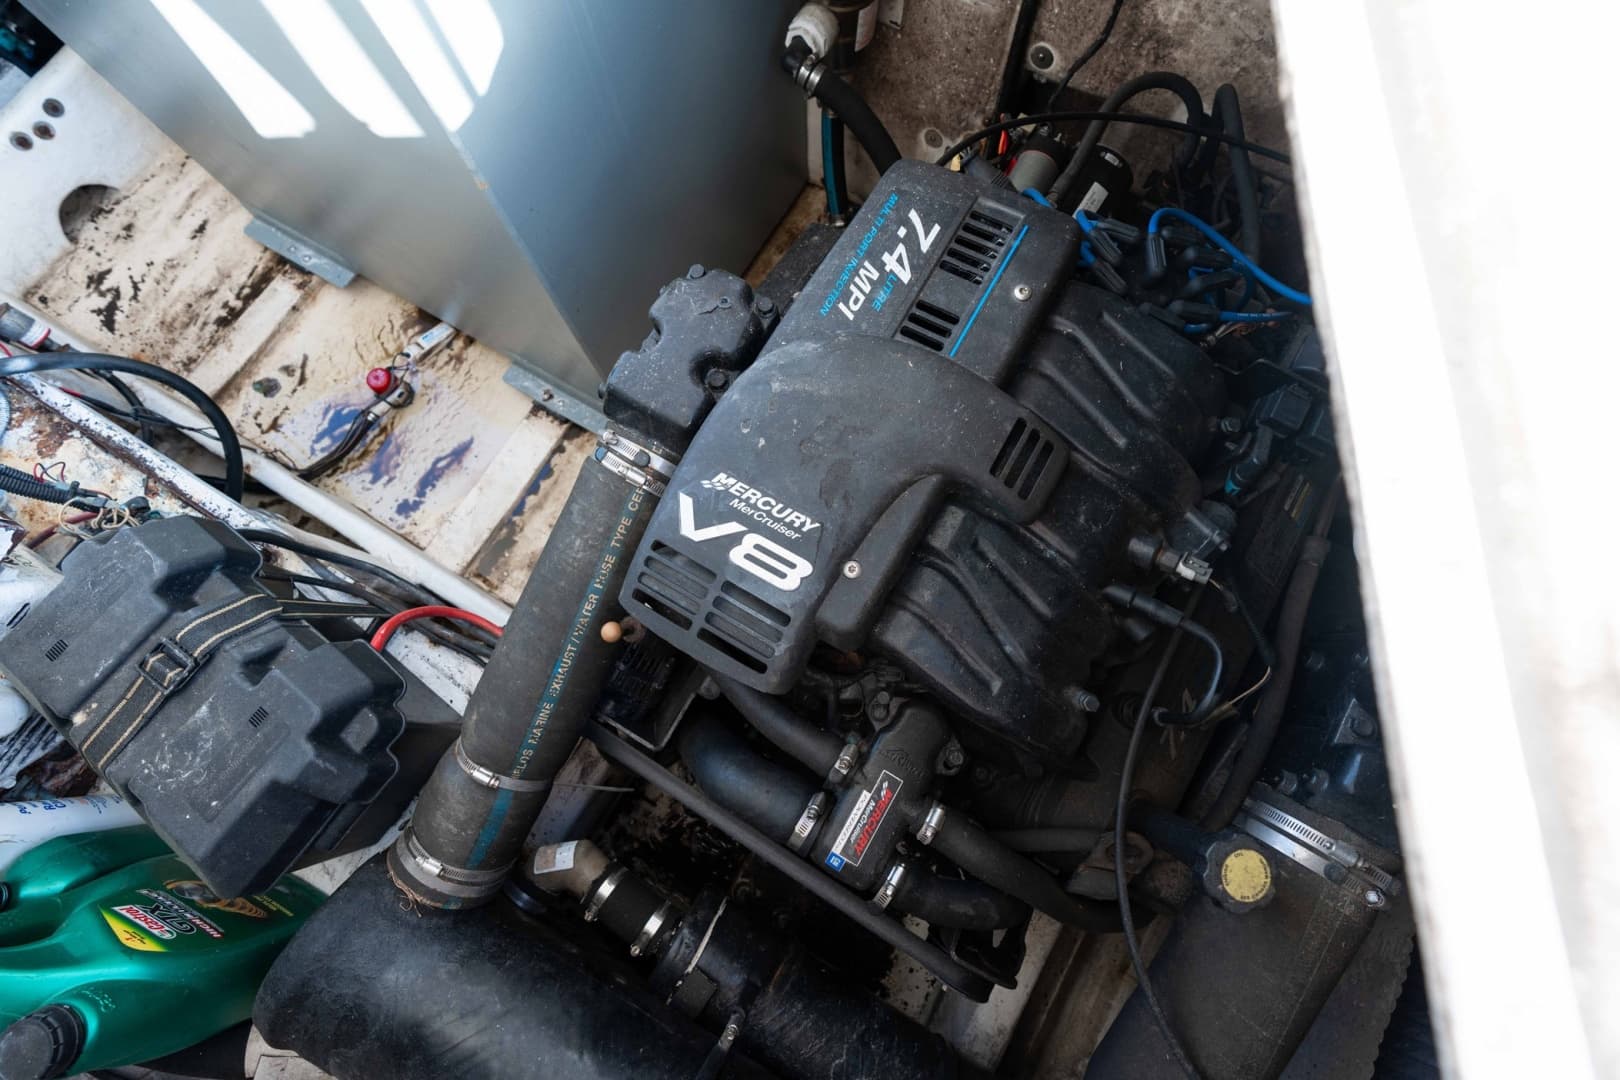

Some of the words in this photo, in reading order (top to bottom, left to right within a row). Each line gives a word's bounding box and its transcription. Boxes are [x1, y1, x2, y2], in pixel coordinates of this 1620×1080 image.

[882, 208, 941, 285] 7.4
[819, 257, 859, 316] INJECTION
[838, 260, 880, 321] MPI
[871, 272, 898, 312] LITRE
[701, 472, 821, 532] MERCURY
[729, 498, 802, 541] MerCruiser
[679, 491, 814, 592] V8
[527, 701, 554, 746] MARINE
[593, 554, 616, 589] HOSE
[611, 516, 633, 548] TYPE
[854, 786, 893, 857] MERCURY
[119, 905, 168, 933] Castrol
[134, 903, 197, 935] GTX
